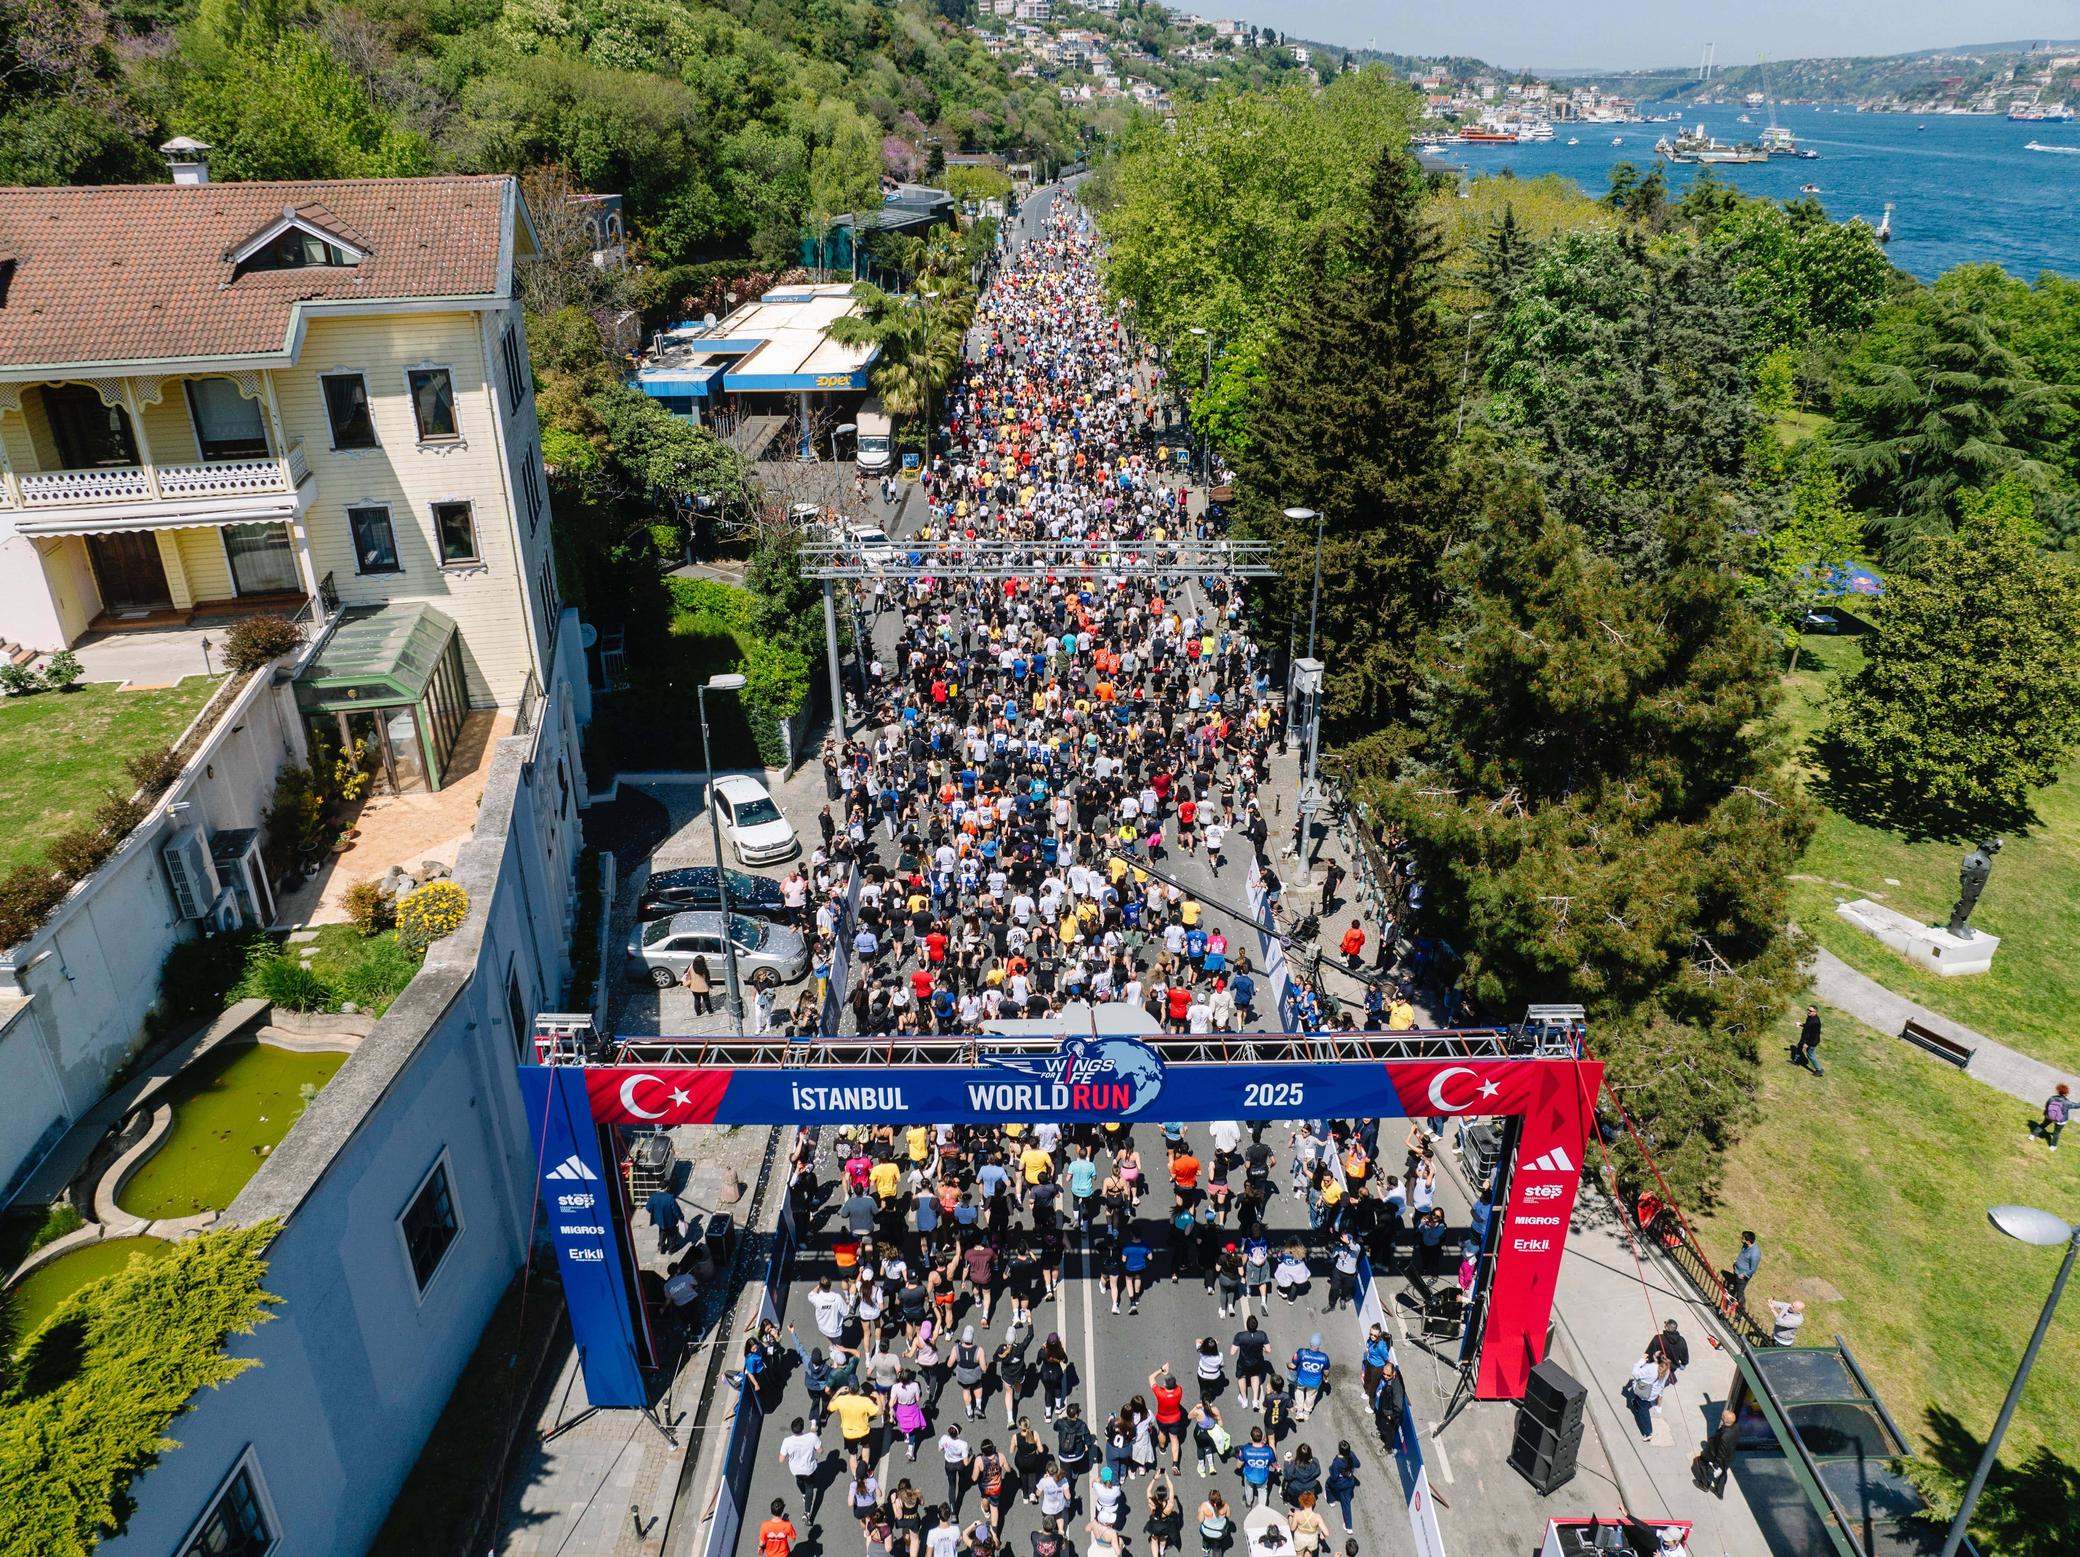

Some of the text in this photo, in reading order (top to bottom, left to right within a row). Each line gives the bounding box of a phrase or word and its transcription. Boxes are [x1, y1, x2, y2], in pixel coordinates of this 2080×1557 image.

[1044, 1058, 1115, 1072] WINGS
[1053, 1072, 1095, 1085] LIFE
[968, 1084, 1129, 1111] WORLD RUN
[1243, 1083, 1304, 1107] 2025
[1515, 1216, 1560, 1225] MIGROS
[560, 1226, 605, 1235] MIGROS
[1513, 1239, 1549, 1250] Erikli
[569, 1248, 604, 1259] Erikli
[1302, 1361, 1325, 1371] GO!
[1113, 1434, 1124, 1448] 9
[1247, 1458, 1269, 1468] GO!
